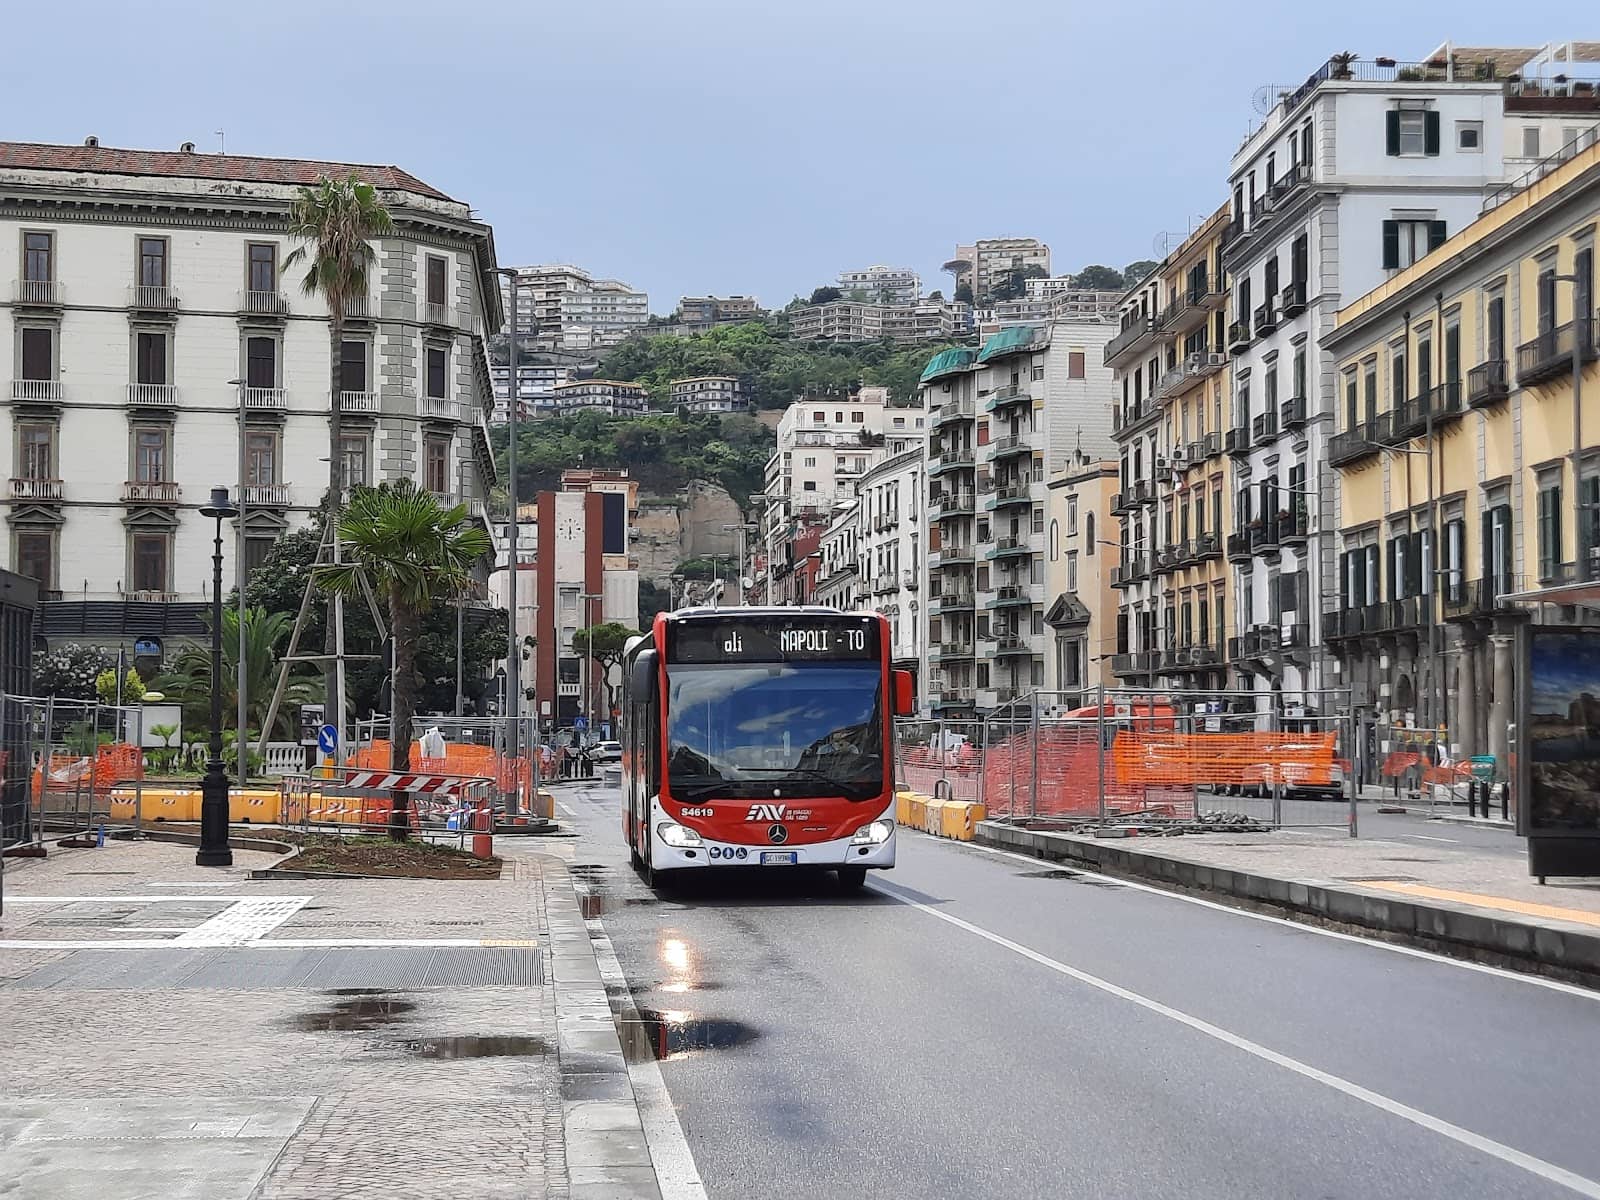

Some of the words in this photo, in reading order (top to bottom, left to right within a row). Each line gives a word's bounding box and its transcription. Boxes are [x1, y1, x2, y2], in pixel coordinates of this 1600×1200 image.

[780, 630, 829, 651] NAPOLI
[846, 630, 865, 651] TO
[681, 807, 714, 817] S4619
